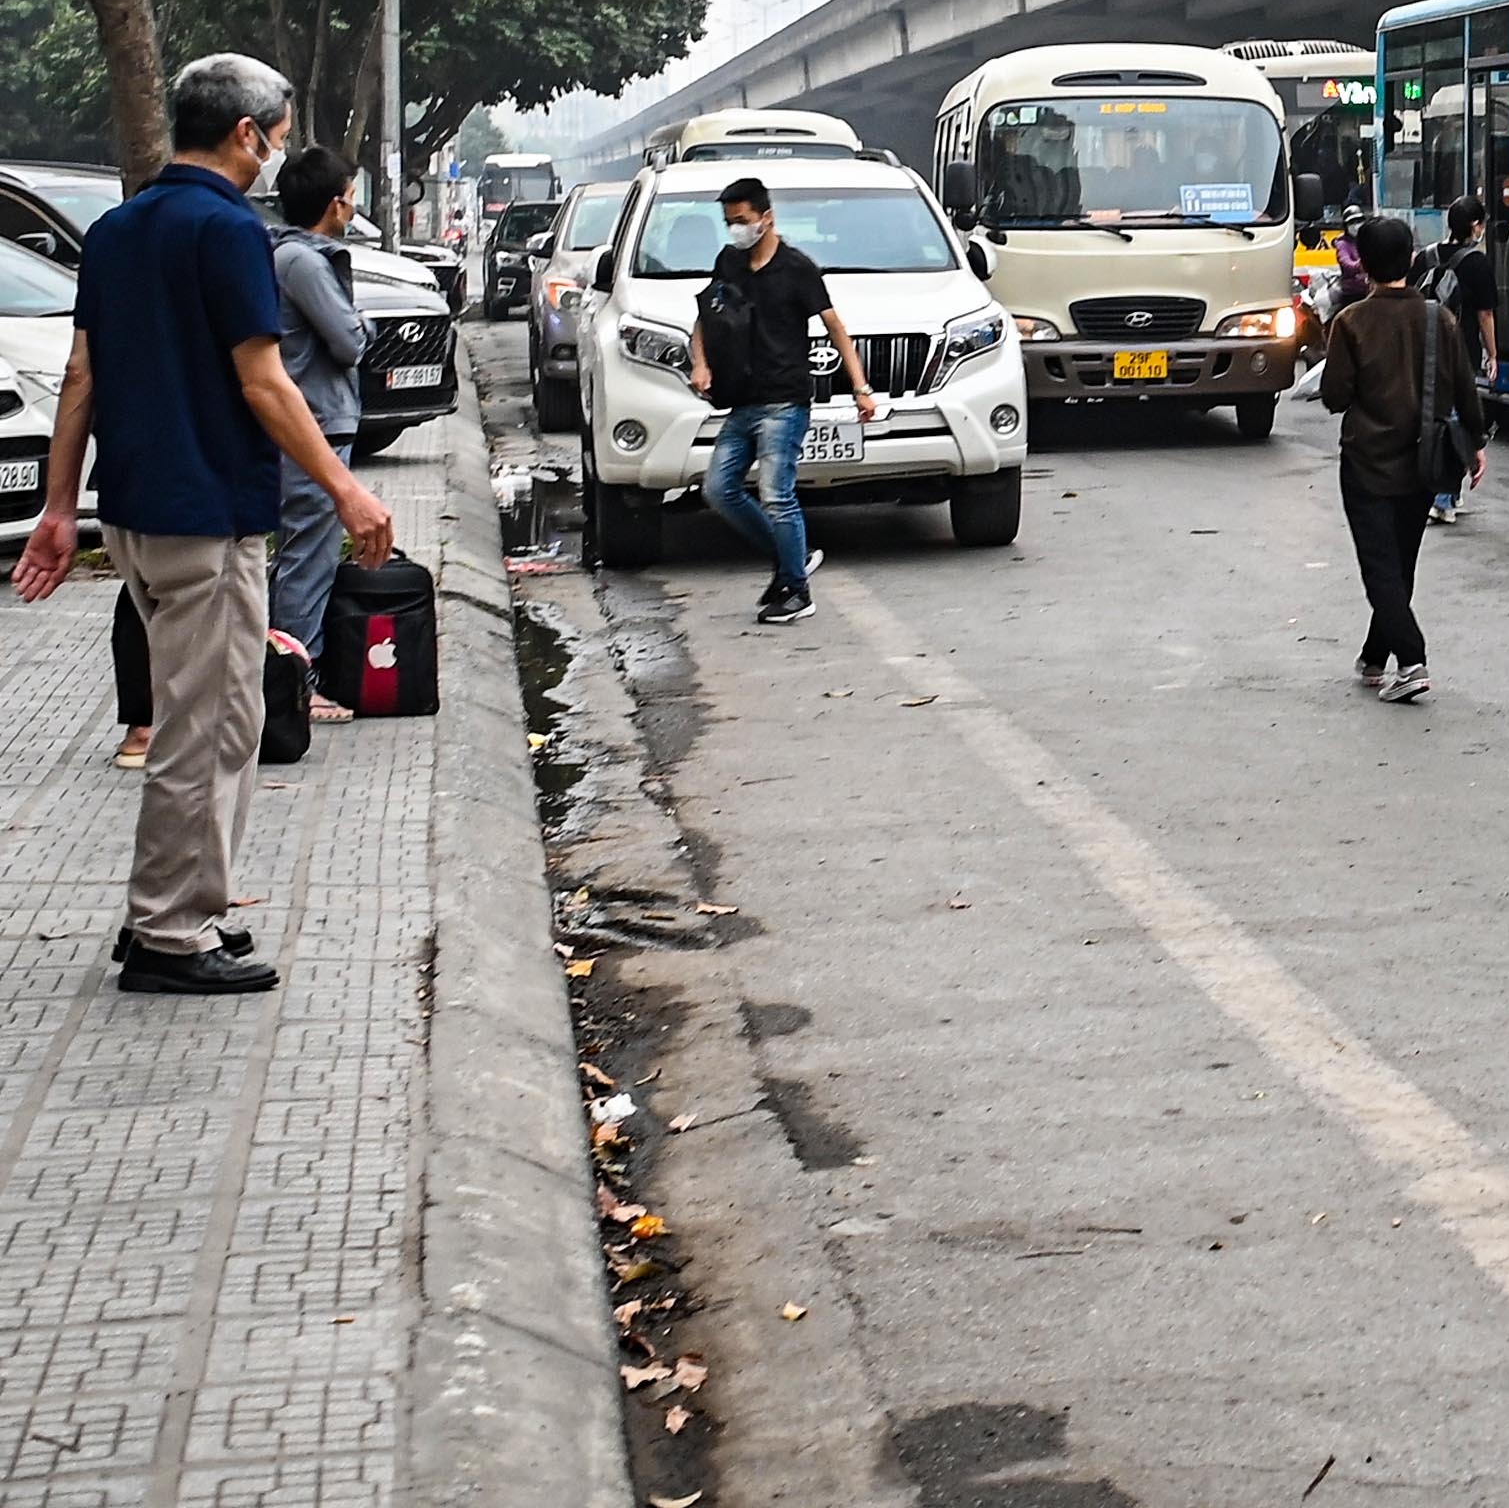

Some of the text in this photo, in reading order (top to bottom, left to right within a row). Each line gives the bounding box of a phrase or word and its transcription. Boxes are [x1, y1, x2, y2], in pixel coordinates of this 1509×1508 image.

[808, 426, 840, 442] 36A
[798, 442, 855, 460] 35.65
[0, 466, 36, 489] 28.90
